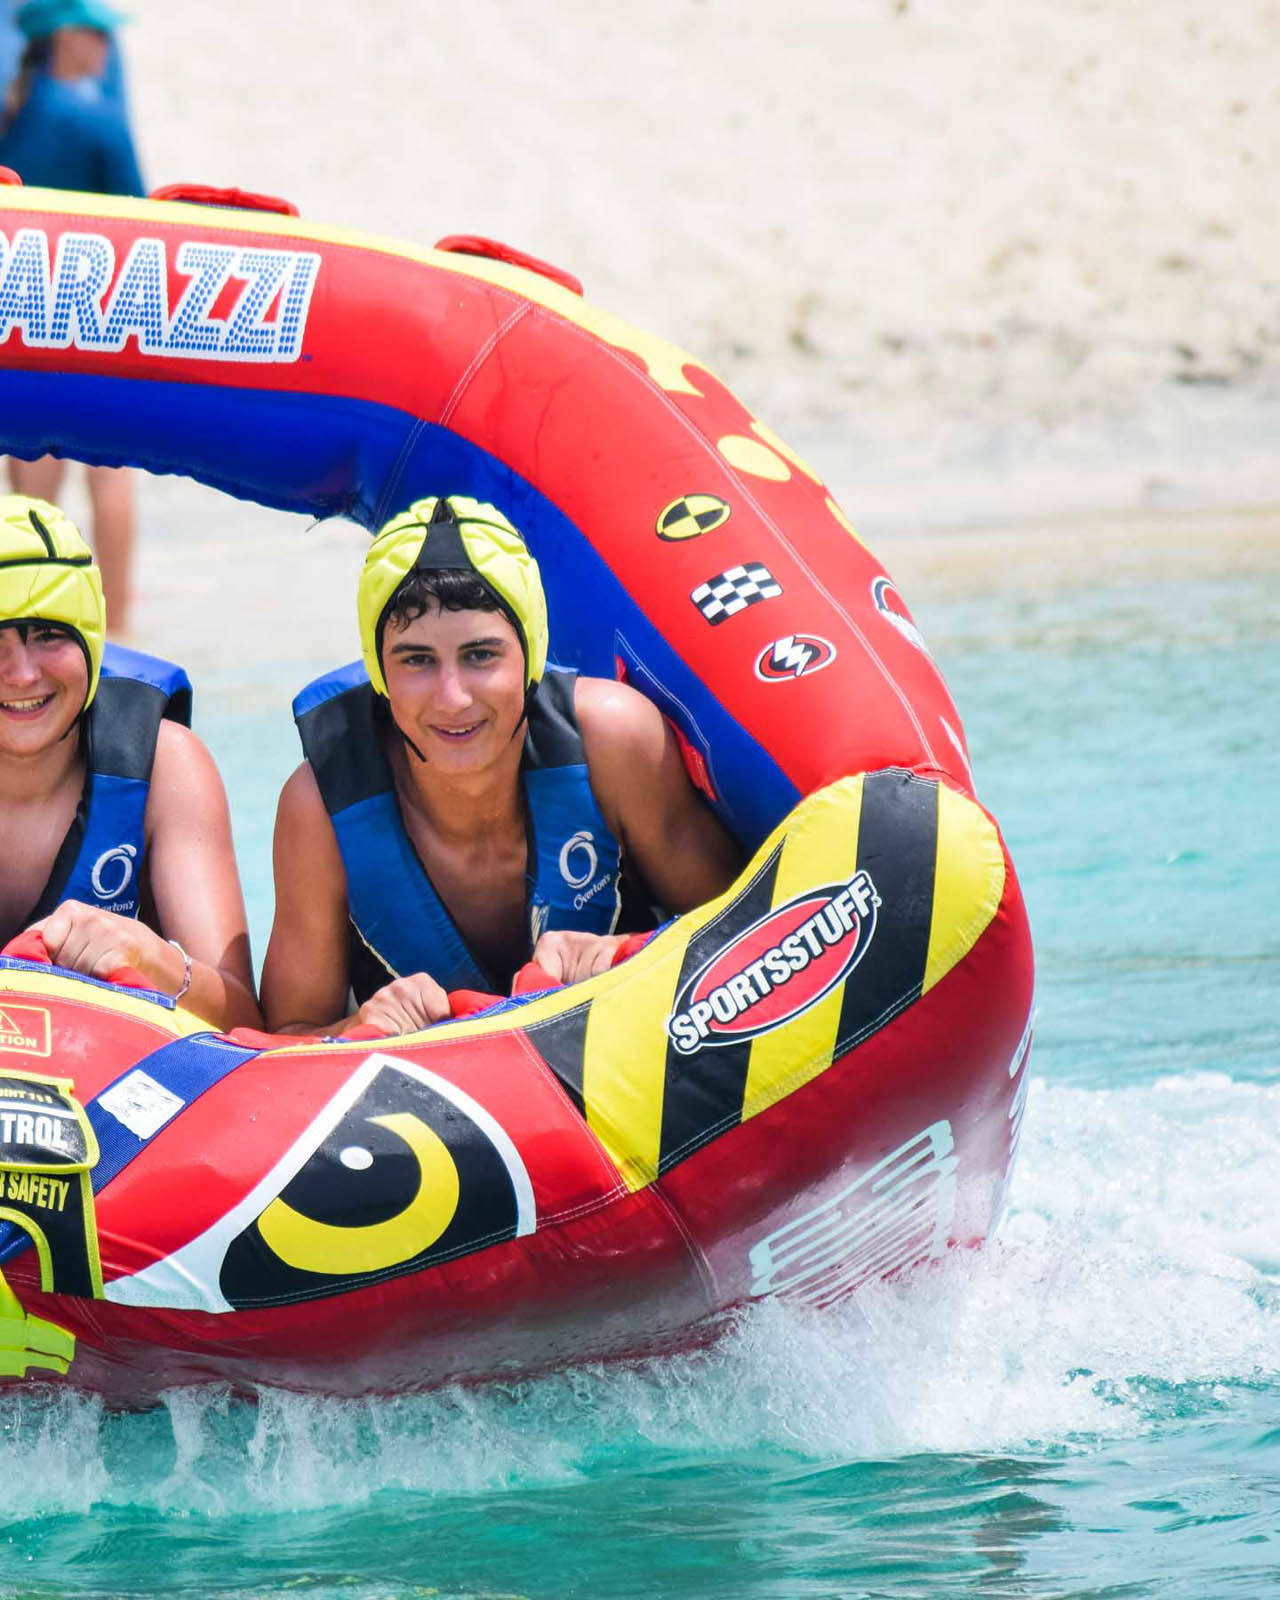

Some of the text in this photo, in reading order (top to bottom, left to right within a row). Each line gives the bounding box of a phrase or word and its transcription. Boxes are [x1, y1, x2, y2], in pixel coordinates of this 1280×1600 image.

[573, 873, 611, 911] Overton's
[669, 873, 876, 1051] SPORTSSTUFF
[7, 1171, 70, 1212] SAFETY
